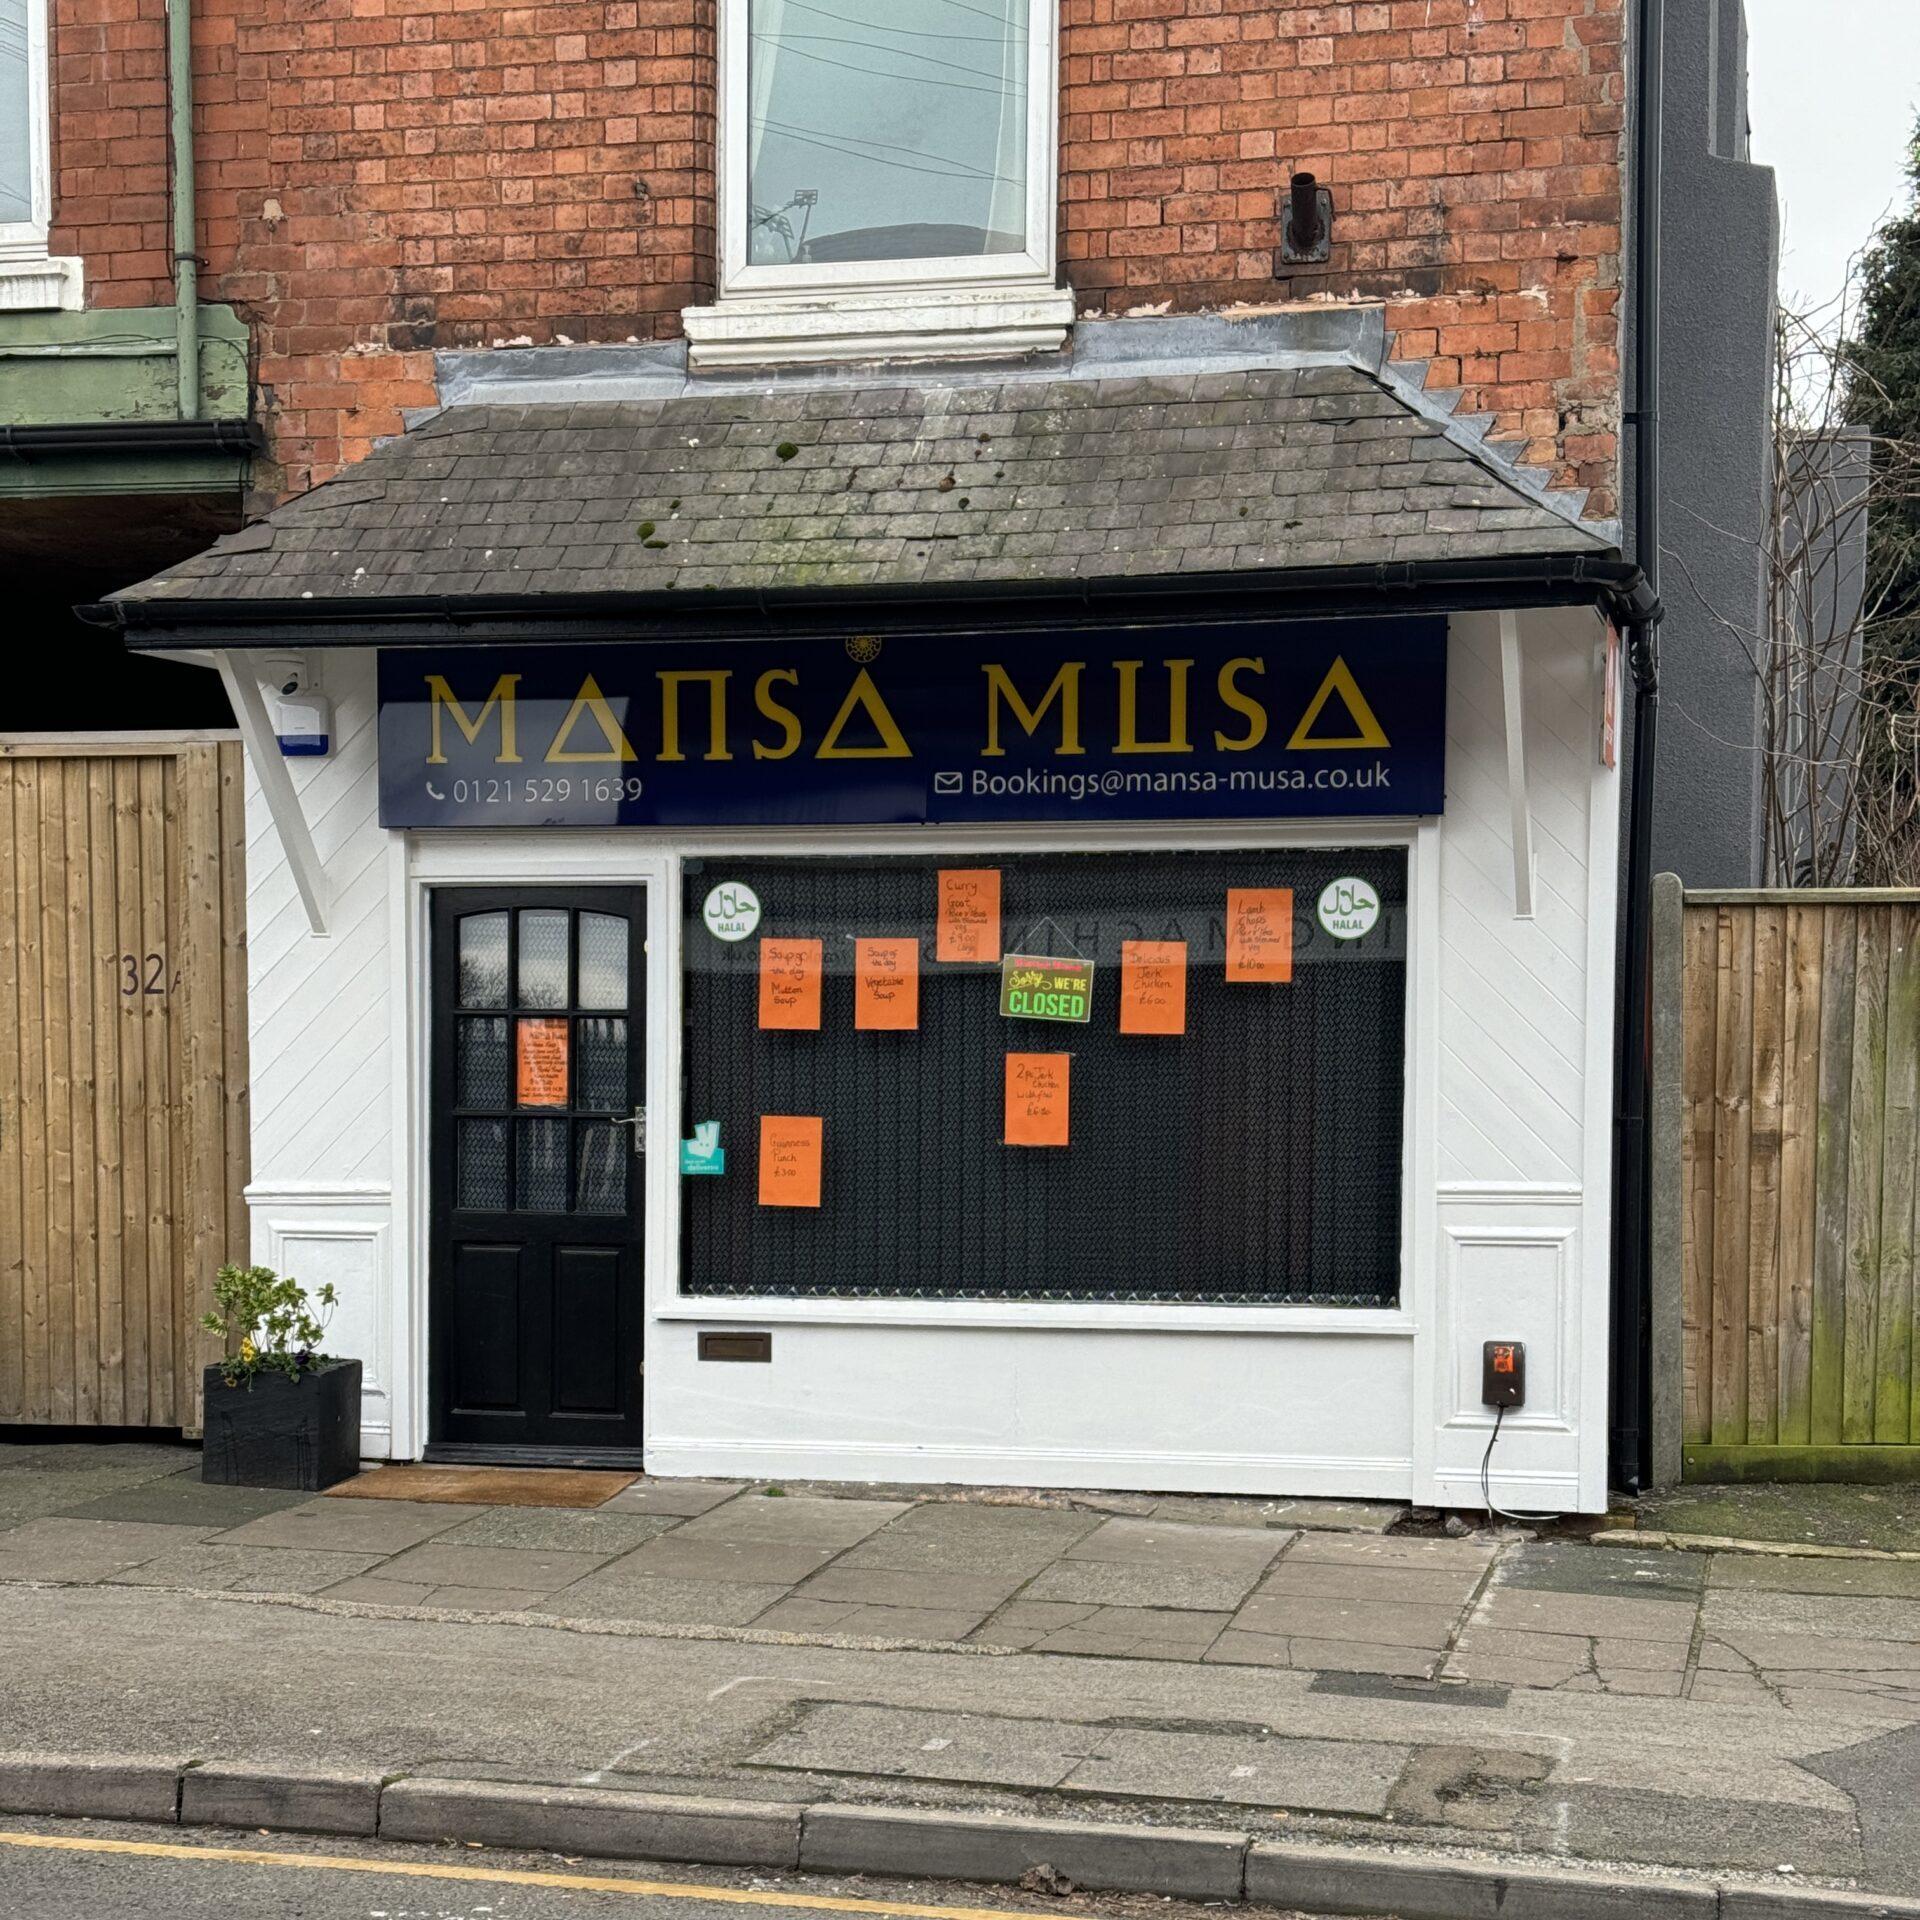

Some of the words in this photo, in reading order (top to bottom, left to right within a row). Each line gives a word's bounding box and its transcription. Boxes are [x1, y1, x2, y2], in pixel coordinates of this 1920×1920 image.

[972, 761, 1391, 799] Bookings@mansa-musa.co.uk
[453, 780, 512, 802] 0121
[525, 779, 571, 802] 529
[581, 778, 642, 801] 1639
[946, 879, 977, 896] Curry
[708, 888, 757, 919] حلال
[947, 895, 971, 908] Goat
[1323, 884, 1376, 916] حلال
[717, 922, 747, 932] HALAL
[1333, 920, 1364, 930] HALAL
[1137, 966, 1162, 979] Jerk
[1054, 976, 1087, 992] WE'RE
[1133, 979, 1173, 992] Chicken
[1009, 990, 1085, 1018] CLOSED
